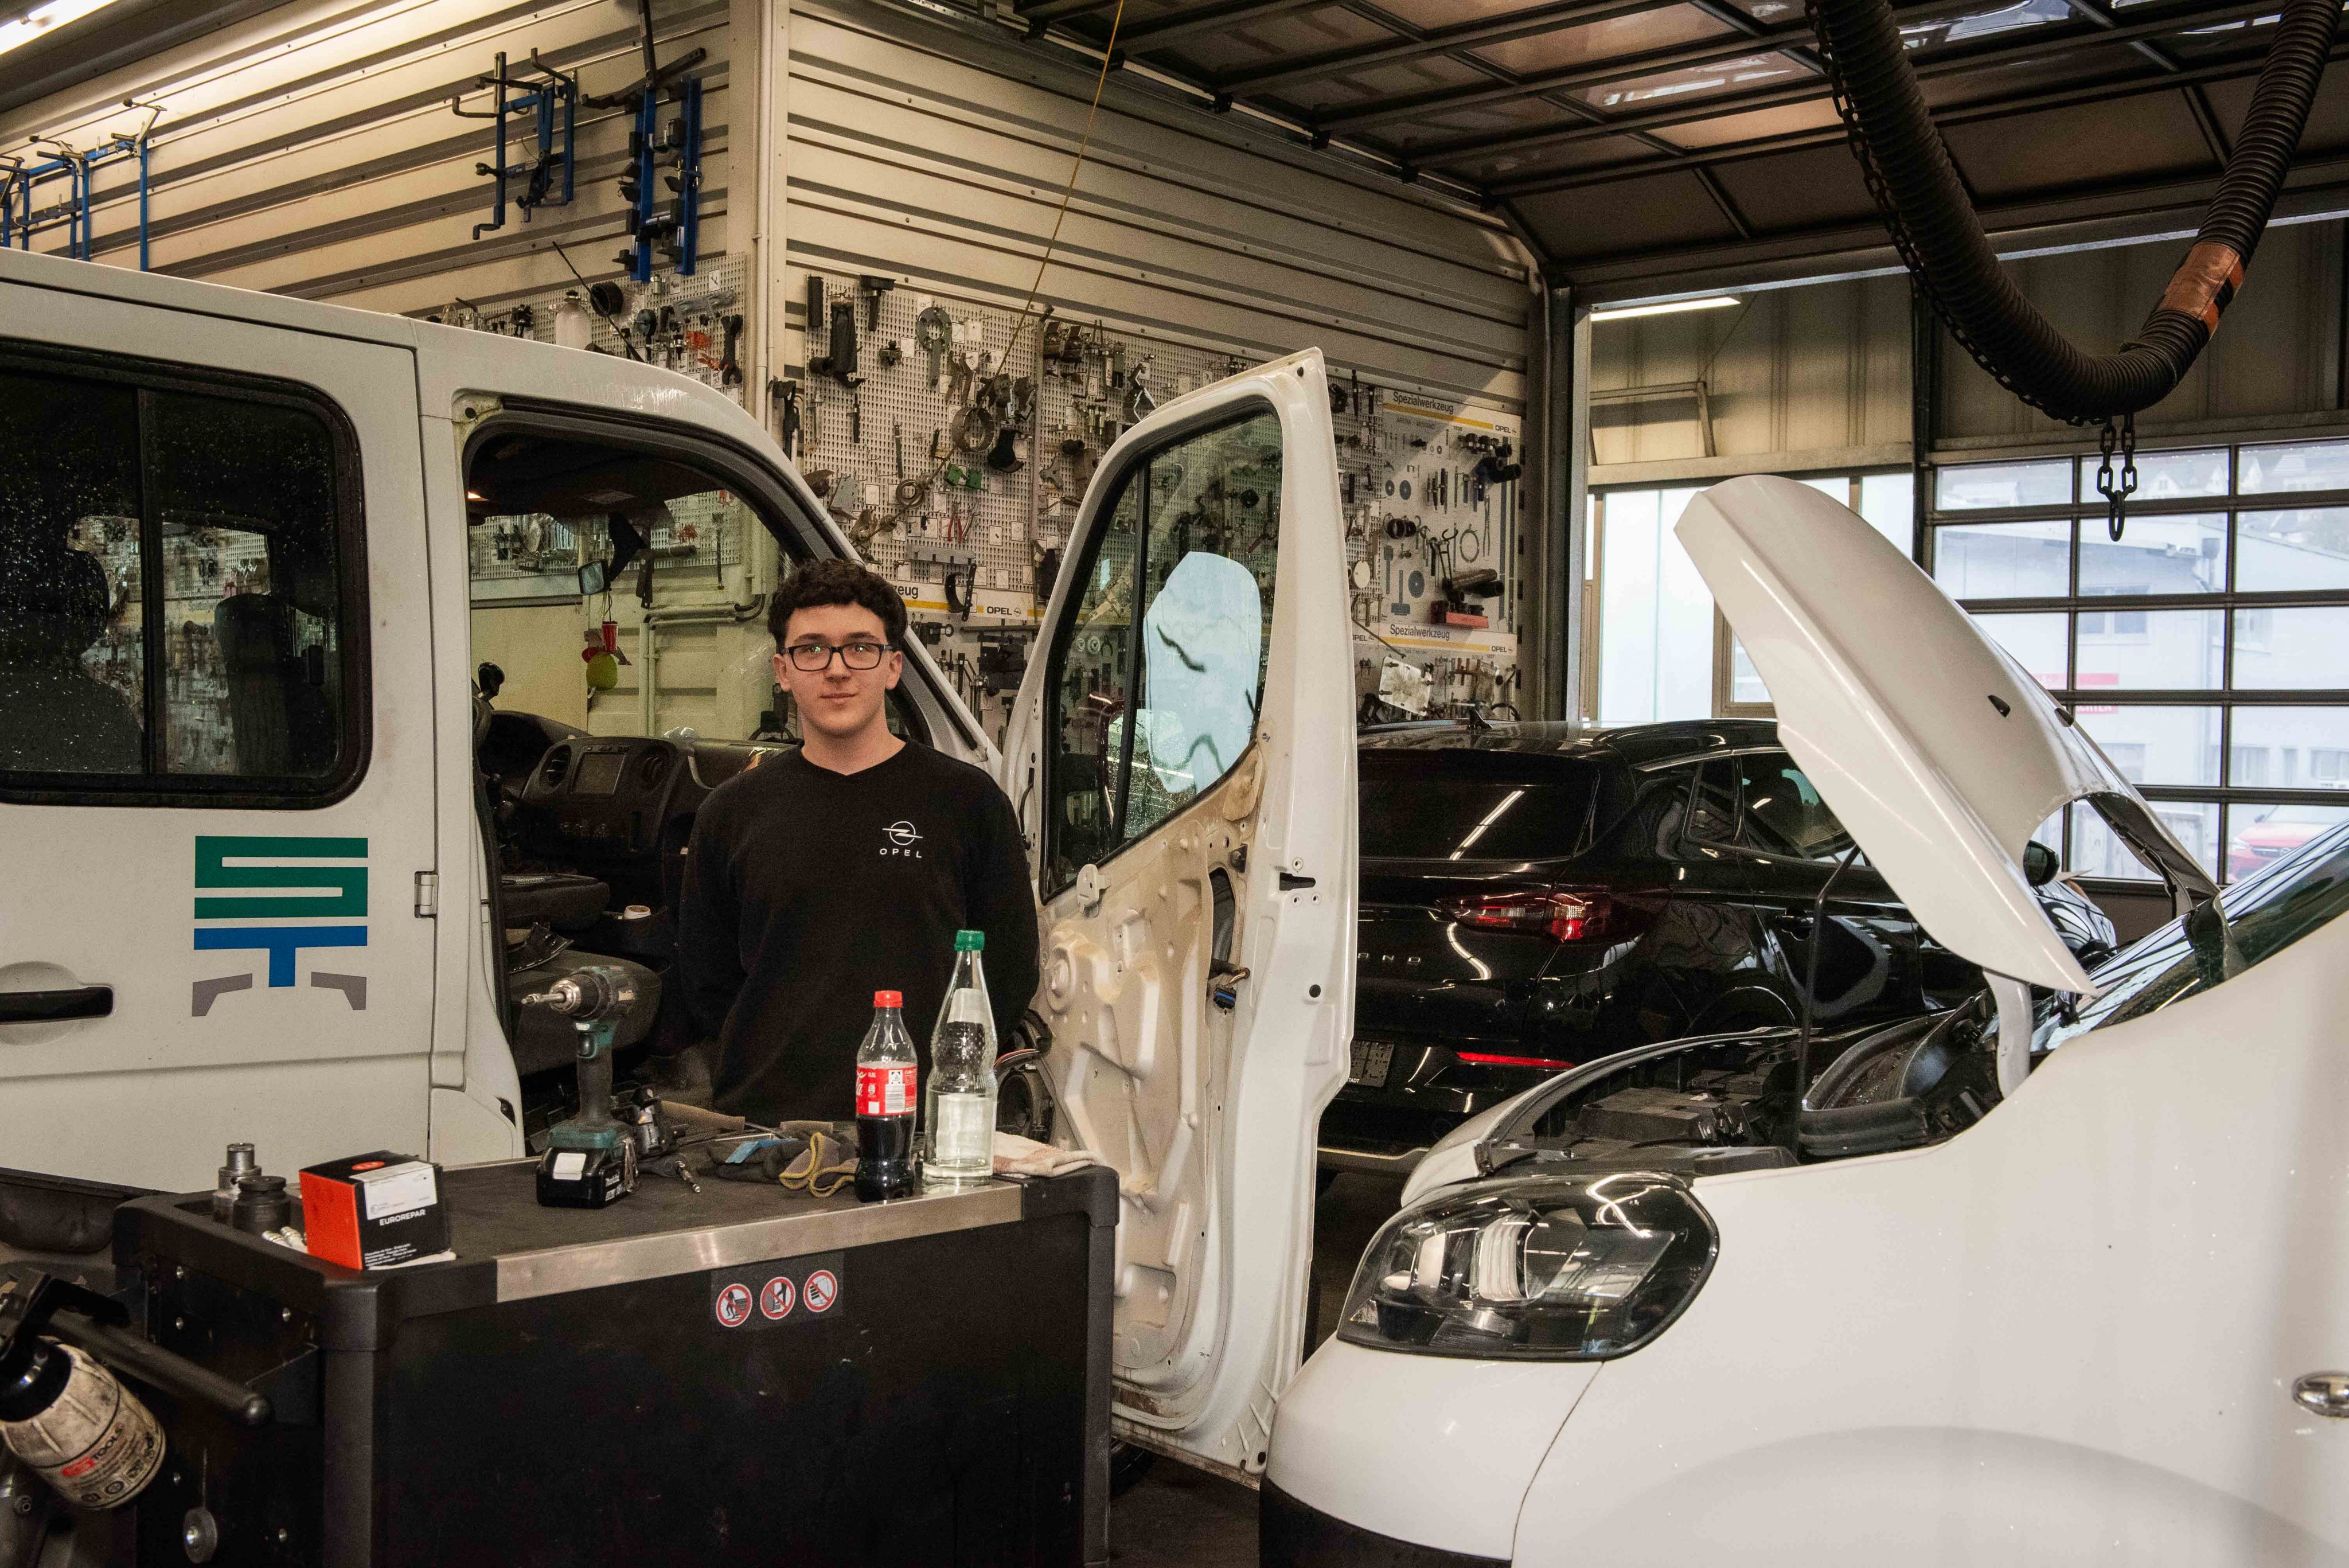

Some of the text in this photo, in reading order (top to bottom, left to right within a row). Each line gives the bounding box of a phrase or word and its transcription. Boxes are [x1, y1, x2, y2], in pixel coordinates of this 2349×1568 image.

[1393, 391, 1454, 415] Spezialwerkzeug
[1495, 424, 1511, 434] OPEL
[986, 606, 1012, 615] OPEL
[1390, 624, 1450, 641] Spezialwerkzeug
[879, 848, 922, 859] OPEL
[379, 1208, 426, 1226] EUROREPAR
[91, 1424, 124, 1460] TOOLS
